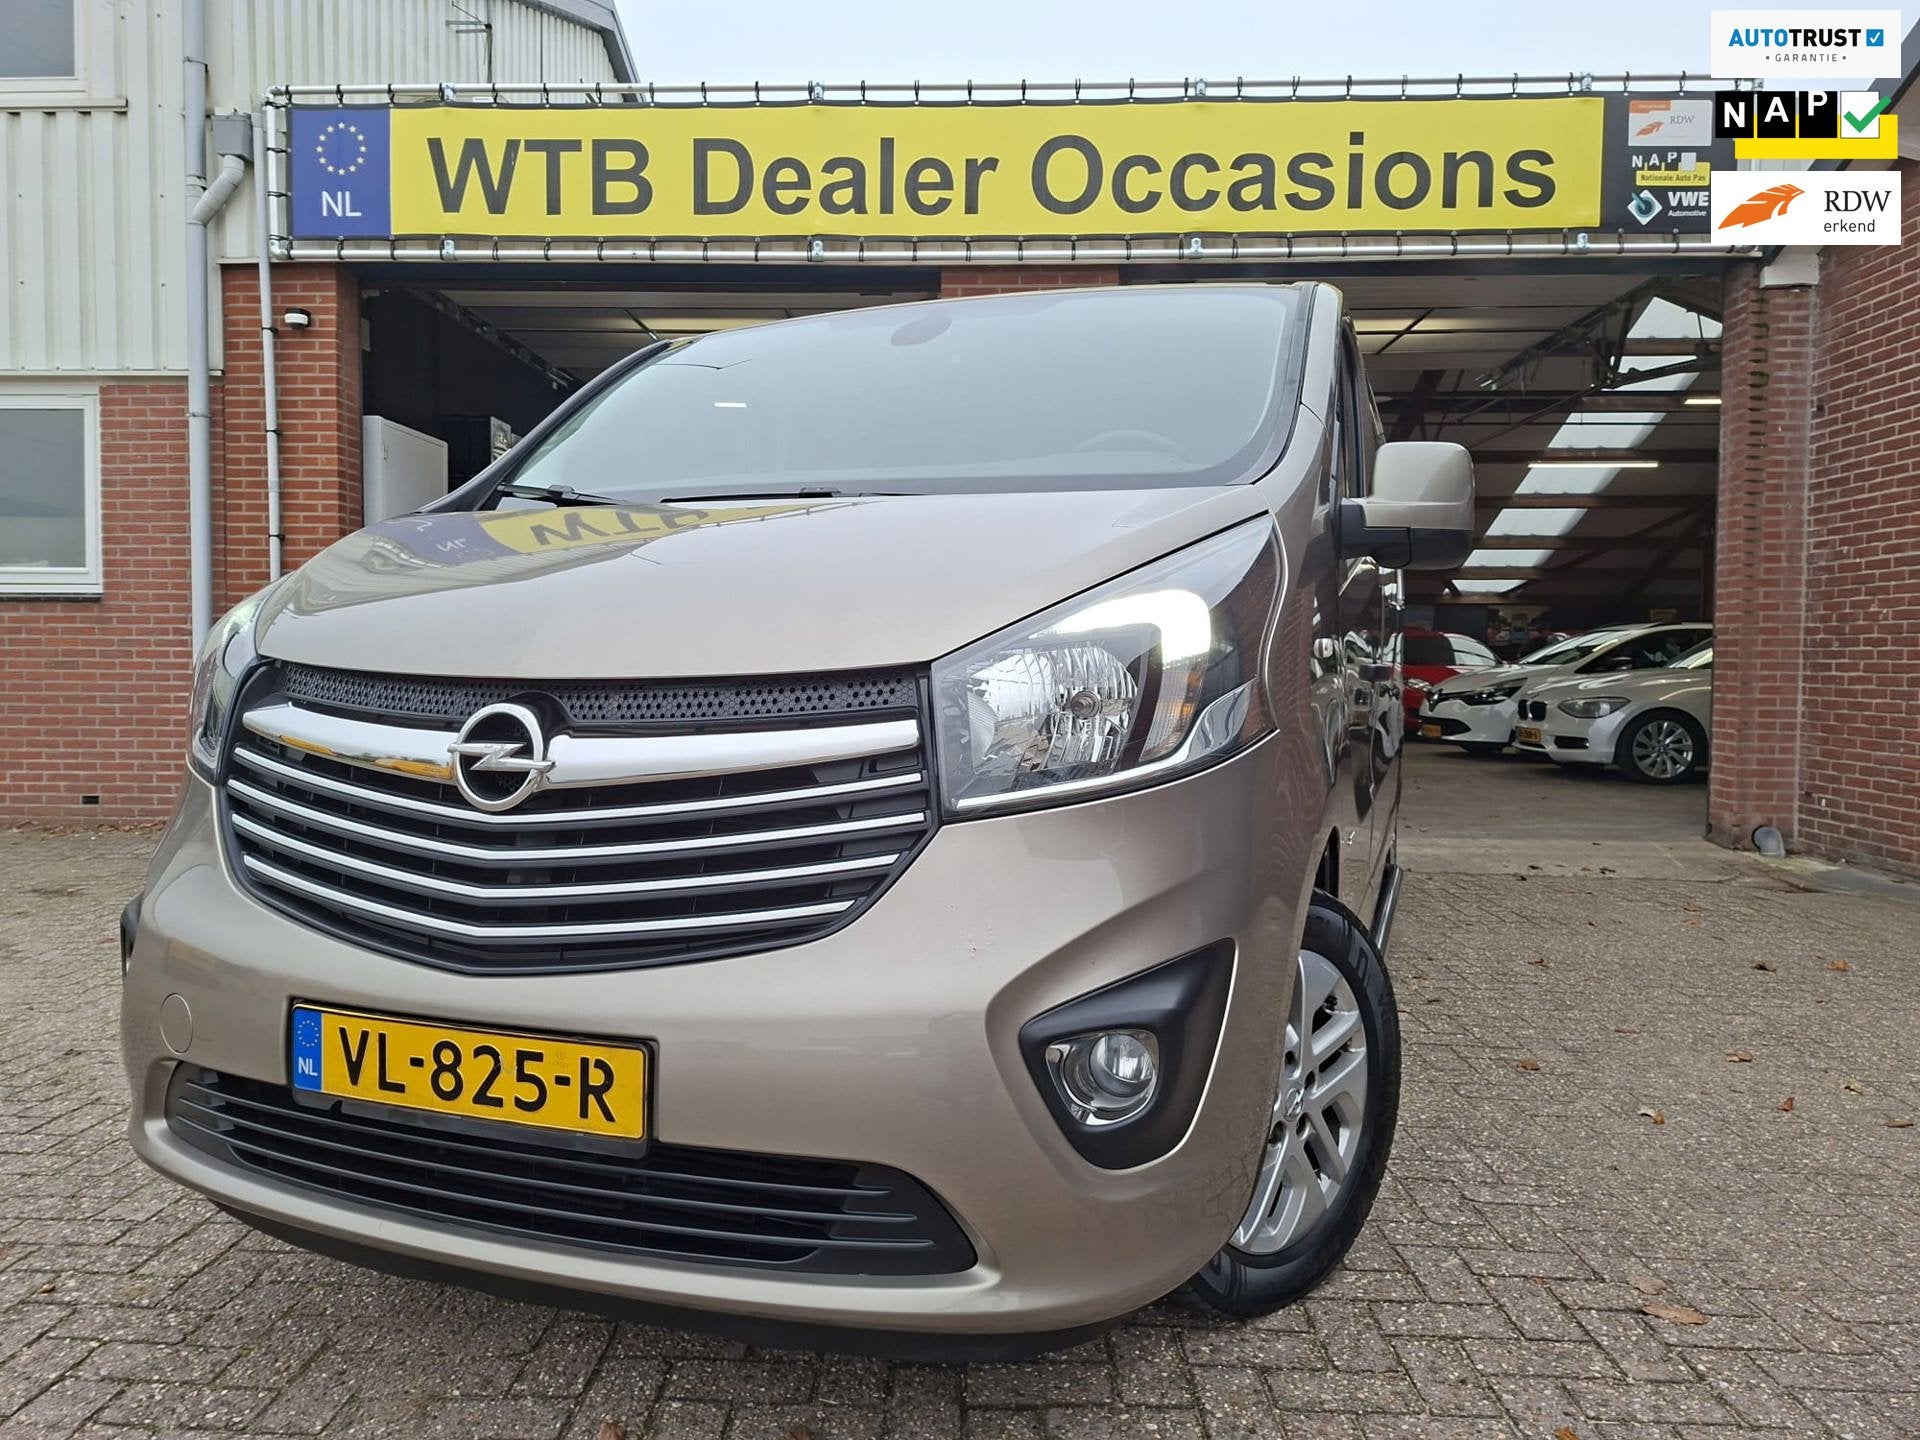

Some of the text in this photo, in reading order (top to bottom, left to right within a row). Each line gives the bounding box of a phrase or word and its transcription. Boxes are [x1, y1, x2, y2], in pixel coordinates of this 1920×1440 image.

[1670, 115, 1695, 125] RDW
[425, 131, 1557, 217] WTB Dealer Occasions
[321, 190, 362, 218] NL
[1667, 191, 1709, 207] VWE
[1667, 209, 1707, 217] Automotive
[298, 1056, 318, 1077] NL
[338, 1025, 616, 1123] VL-825-R
